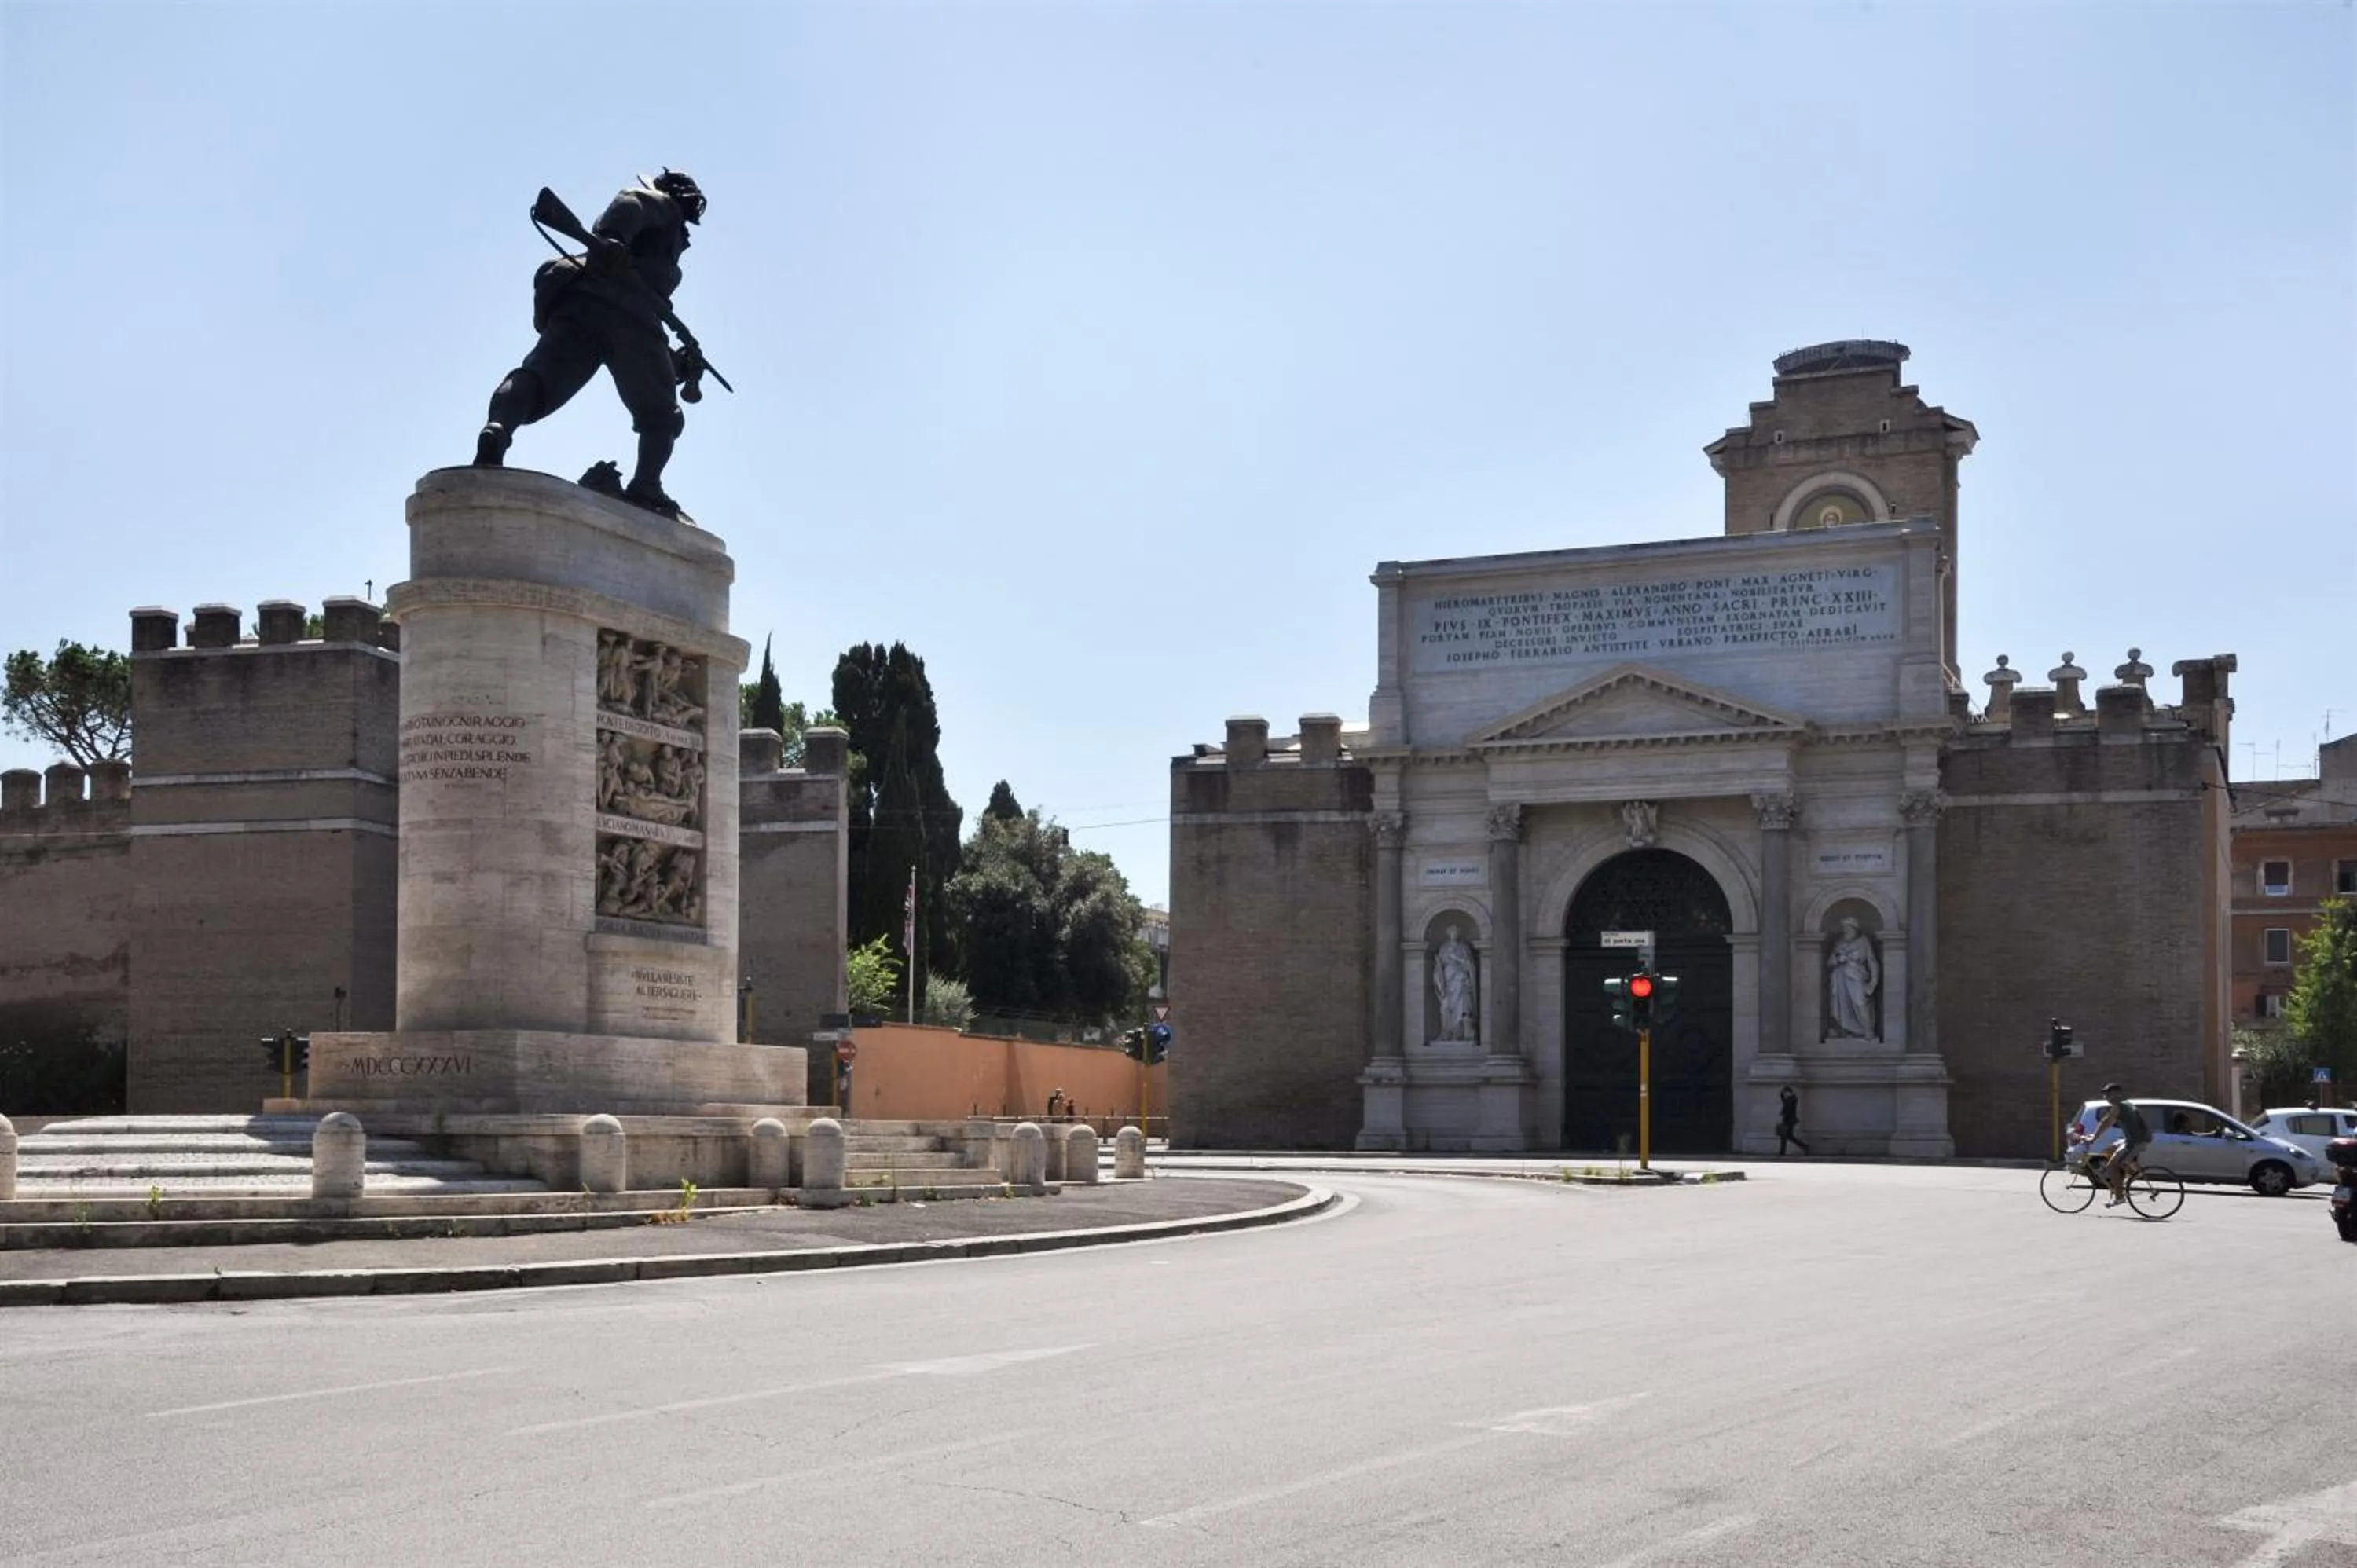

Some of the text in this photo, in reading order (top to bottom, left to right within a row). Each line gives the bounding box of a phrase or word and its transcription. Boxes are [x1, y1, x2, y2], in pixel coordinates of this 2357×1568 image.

[1553, 588, 1600, 602] MAGNIS
[1611, 581, 1687, 597] ALEXANDRO
[1695, 578, 1731, 590] PONT
[1741, 576, 1769, 586] MAX
[1780, 570, 1829, 584] AGNETI
[1613, 597, 1633, 607] VIA
[1644, 591, 1719, 605] NOMENTANA
[1730, 583, 1813, 598] NOBILITATVR
[1434, 619, 1467, 633] PIVS
[1478, 617, 1492, 629] IX
[1501, 612, 1571, 628] PONTIFEX
[1582, 606, 1655, 621] MAXIMVS
[1662, 603, 1703, 617] ANNO
[1712, 599, 1758, 613] SACRI
[1771, 593, 1822, 609] PRINC
[1420, 631, 1470, 644] PORTAM
[1479, 629, 1507, 640] PIAM
[1627, 614, 1715, 630] COMMVNITAM
[1809, 602, 1887, 617] DEDICAVIT
[1565, 631, 1618, 643] INVICTO
[1446, 650, 1501, 663] IOSEPHO
[1583, 639, 1649, 654] ANTISTITE
[1659, 635, 1713, 649] VRBANO
[473, 715, 526, 729] RAGGIO
[446, 732, 517, 746] CORAGGIO
[474, 750, 532, 764] SPLENDE
[430, 768, 464, 780] SENZA
